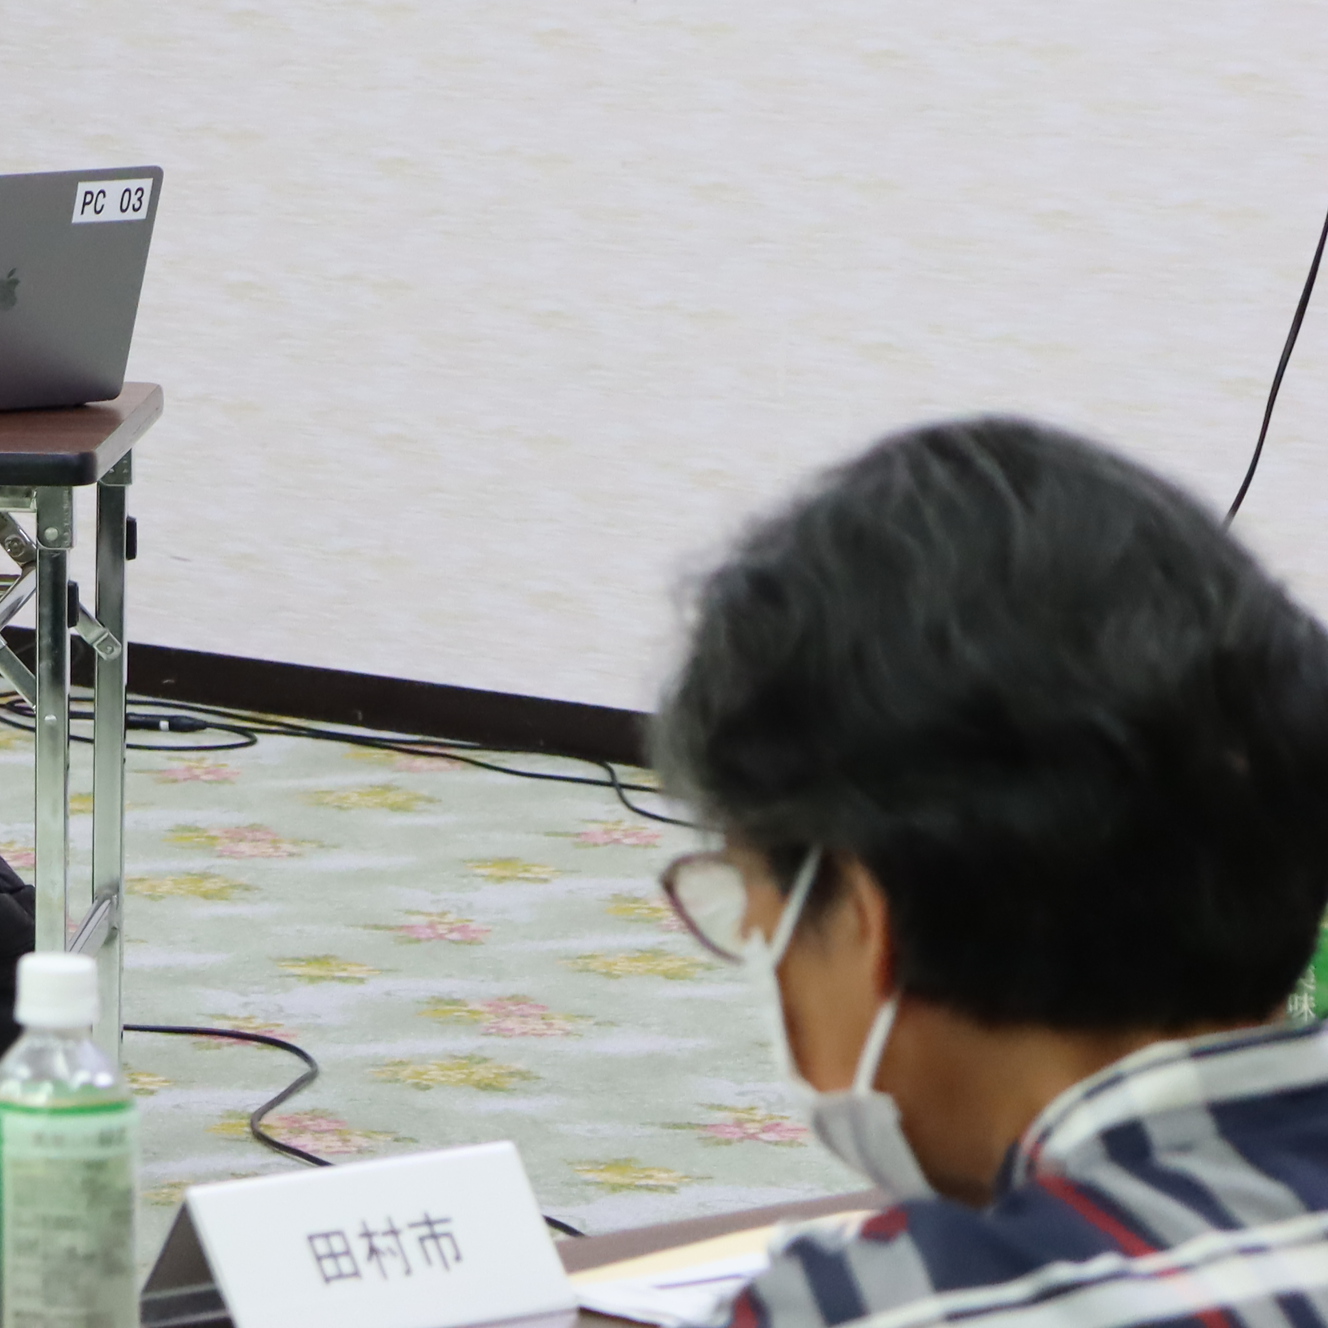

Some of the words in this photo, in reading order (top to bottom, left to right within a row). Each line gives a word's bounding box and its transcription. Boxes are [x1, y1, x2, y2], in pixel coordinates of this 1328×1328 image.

[80, 190, 107, 216] PC
[118, 186, 145, 214] 03
[306, 1211, 464, 1285] 田村市
